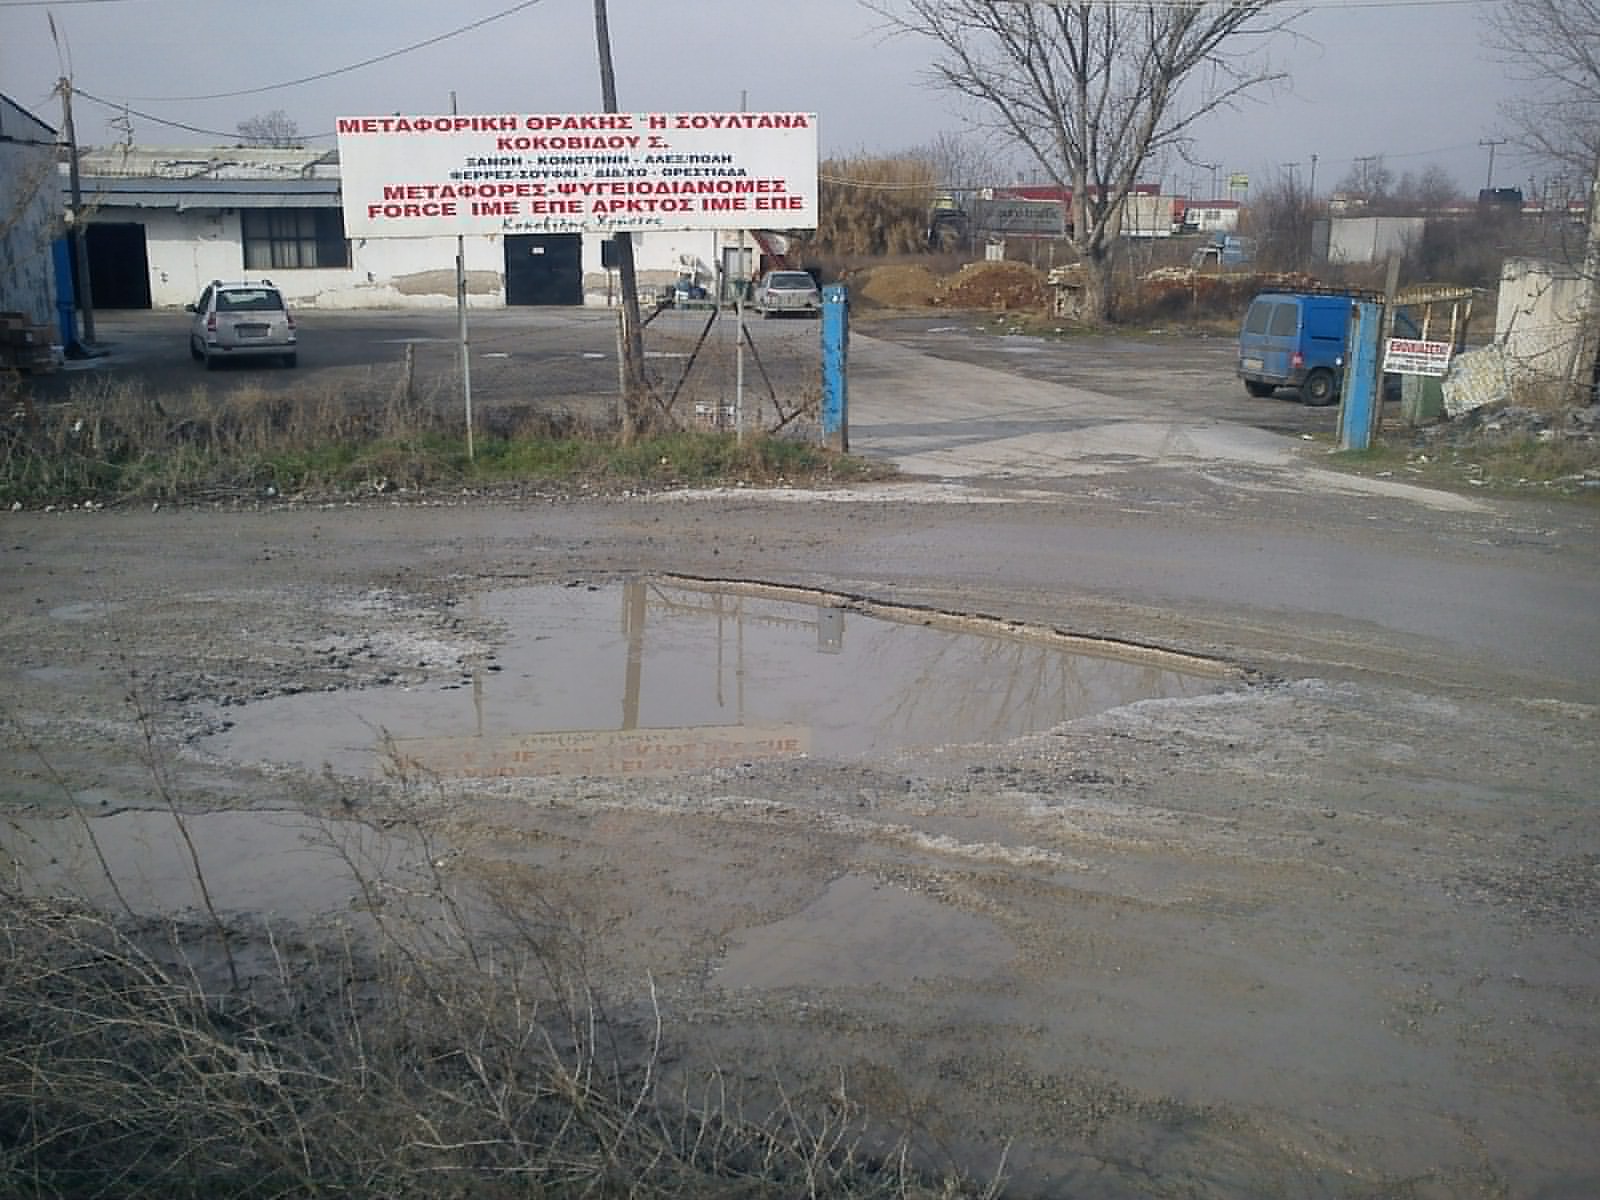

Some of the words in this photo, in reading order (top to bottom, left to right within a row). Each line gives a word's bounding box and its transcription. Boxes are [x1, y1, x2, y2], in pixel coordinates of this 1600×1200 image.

[338, 117, 516, 133] ΜΕΤΑΦΟΡΙΚΗ
[525, 115, 633, 131] ΘΡΑΚΗΣ
[497, 136, 641, 150] ΚΟΚΟΒΙΔΟΥ
[647, 136, 672, 149] Σ.
[537, 154, 630, 166] ΚΟΜΟΤΗΝΗ
[661, 166, 747, 177] ΟΡΕΣΤΙΑΔΑ
[367, 202, 457, 218] FORCE
[531, 200, 584, 214] ΕΠΕ
[591, 199, 695, 213] ΑΡΚΤΟΣ
[755, 196, 804, 210] ΕΠΕ
